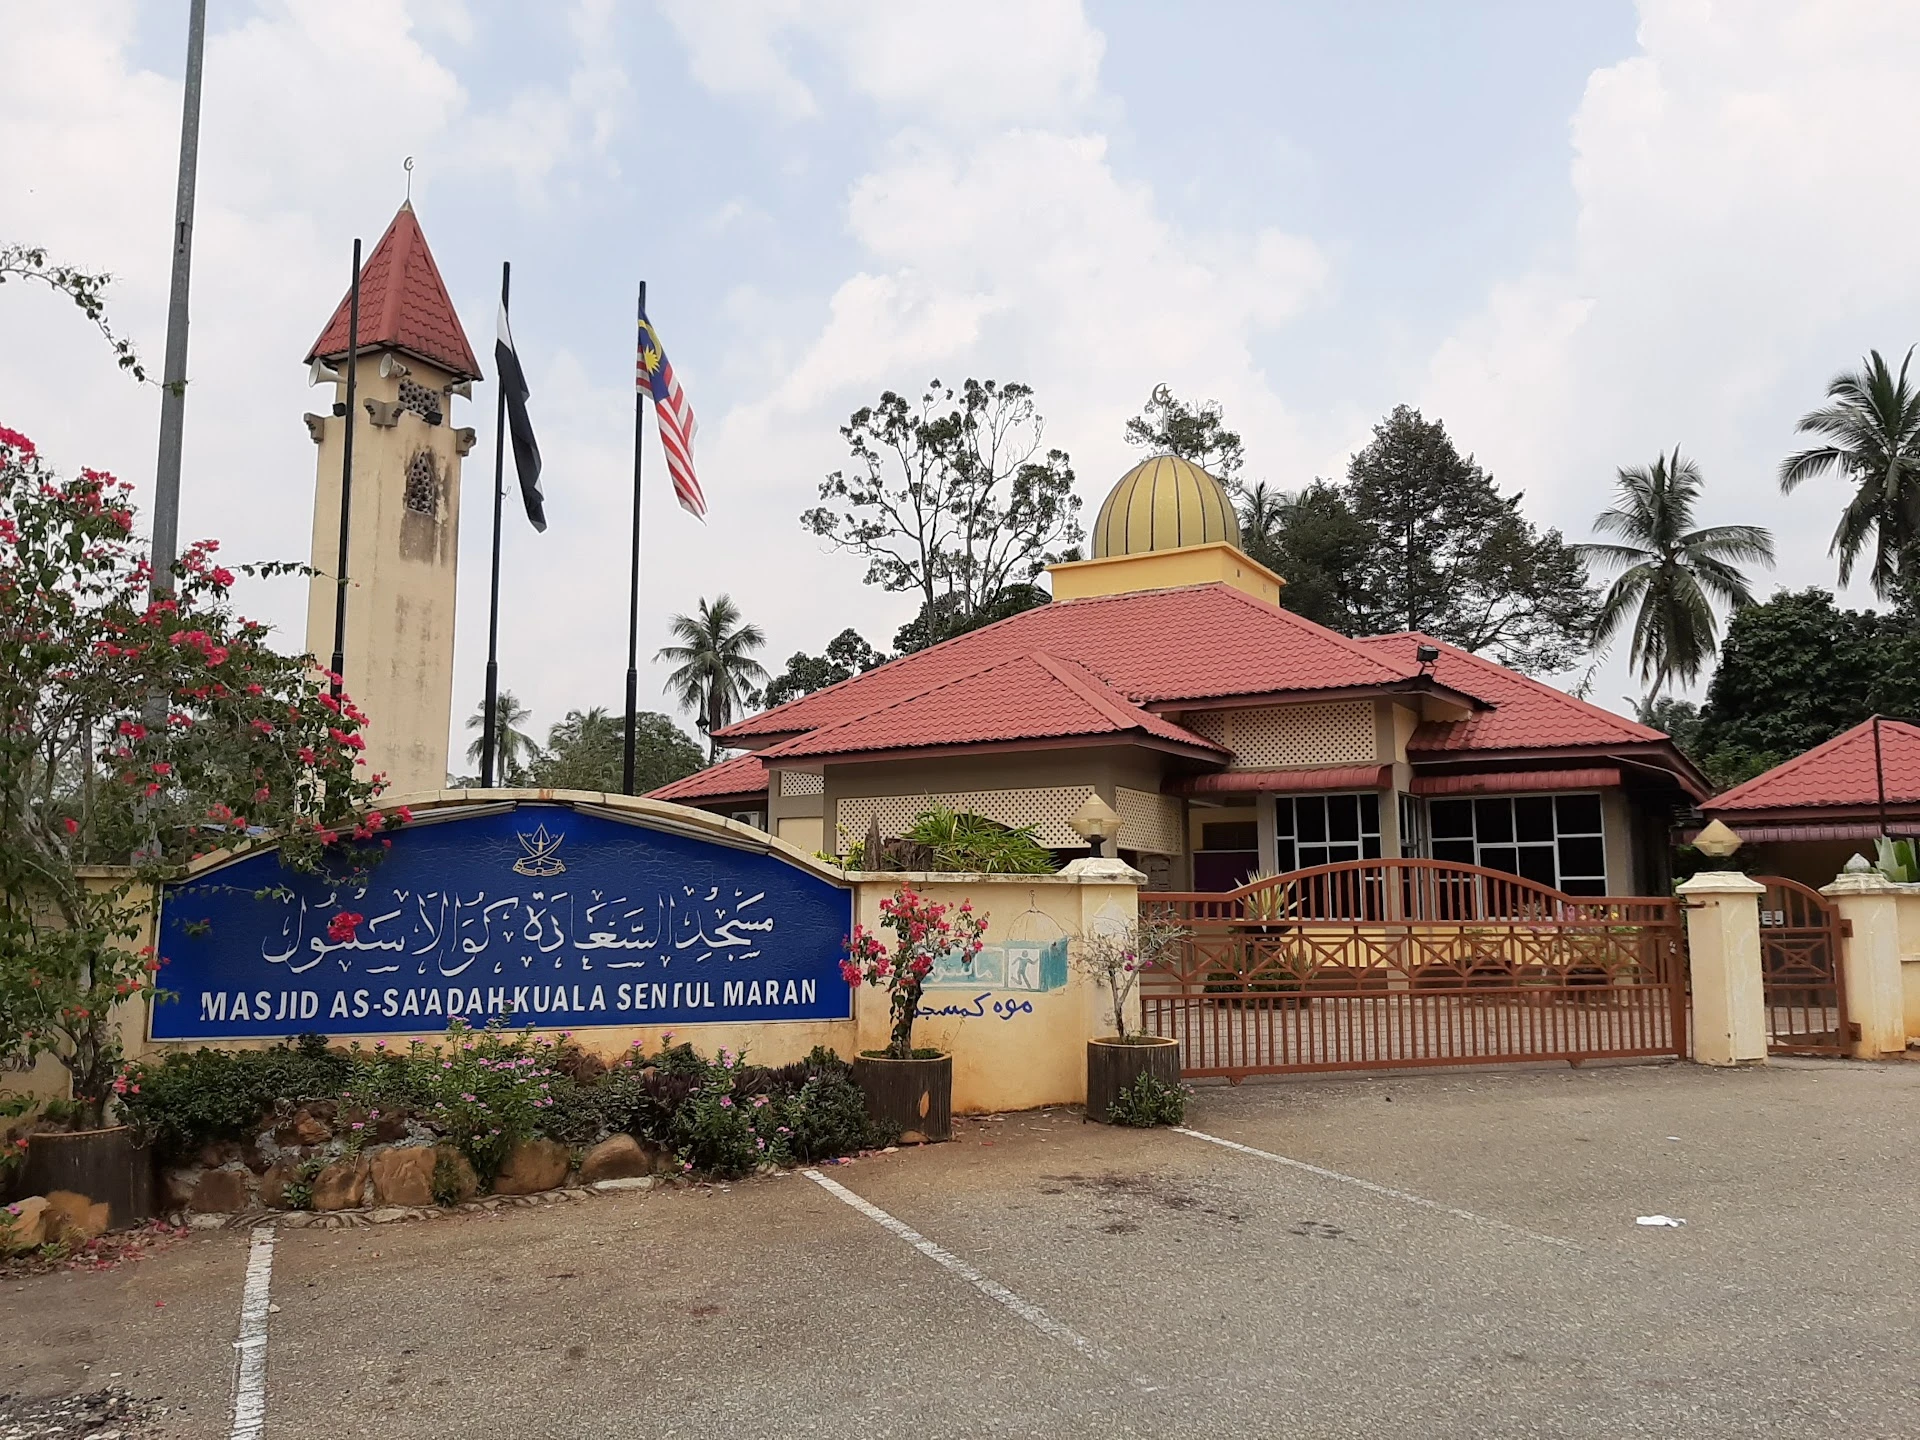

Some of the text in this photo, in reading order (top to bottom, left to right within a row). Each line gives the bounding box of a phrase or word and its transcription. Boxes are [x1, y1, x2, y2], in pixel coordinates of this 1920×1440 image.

[200, 978, 816, 1021] MASJID AS-SA'ADAH KUALA SENTUL MARAN
